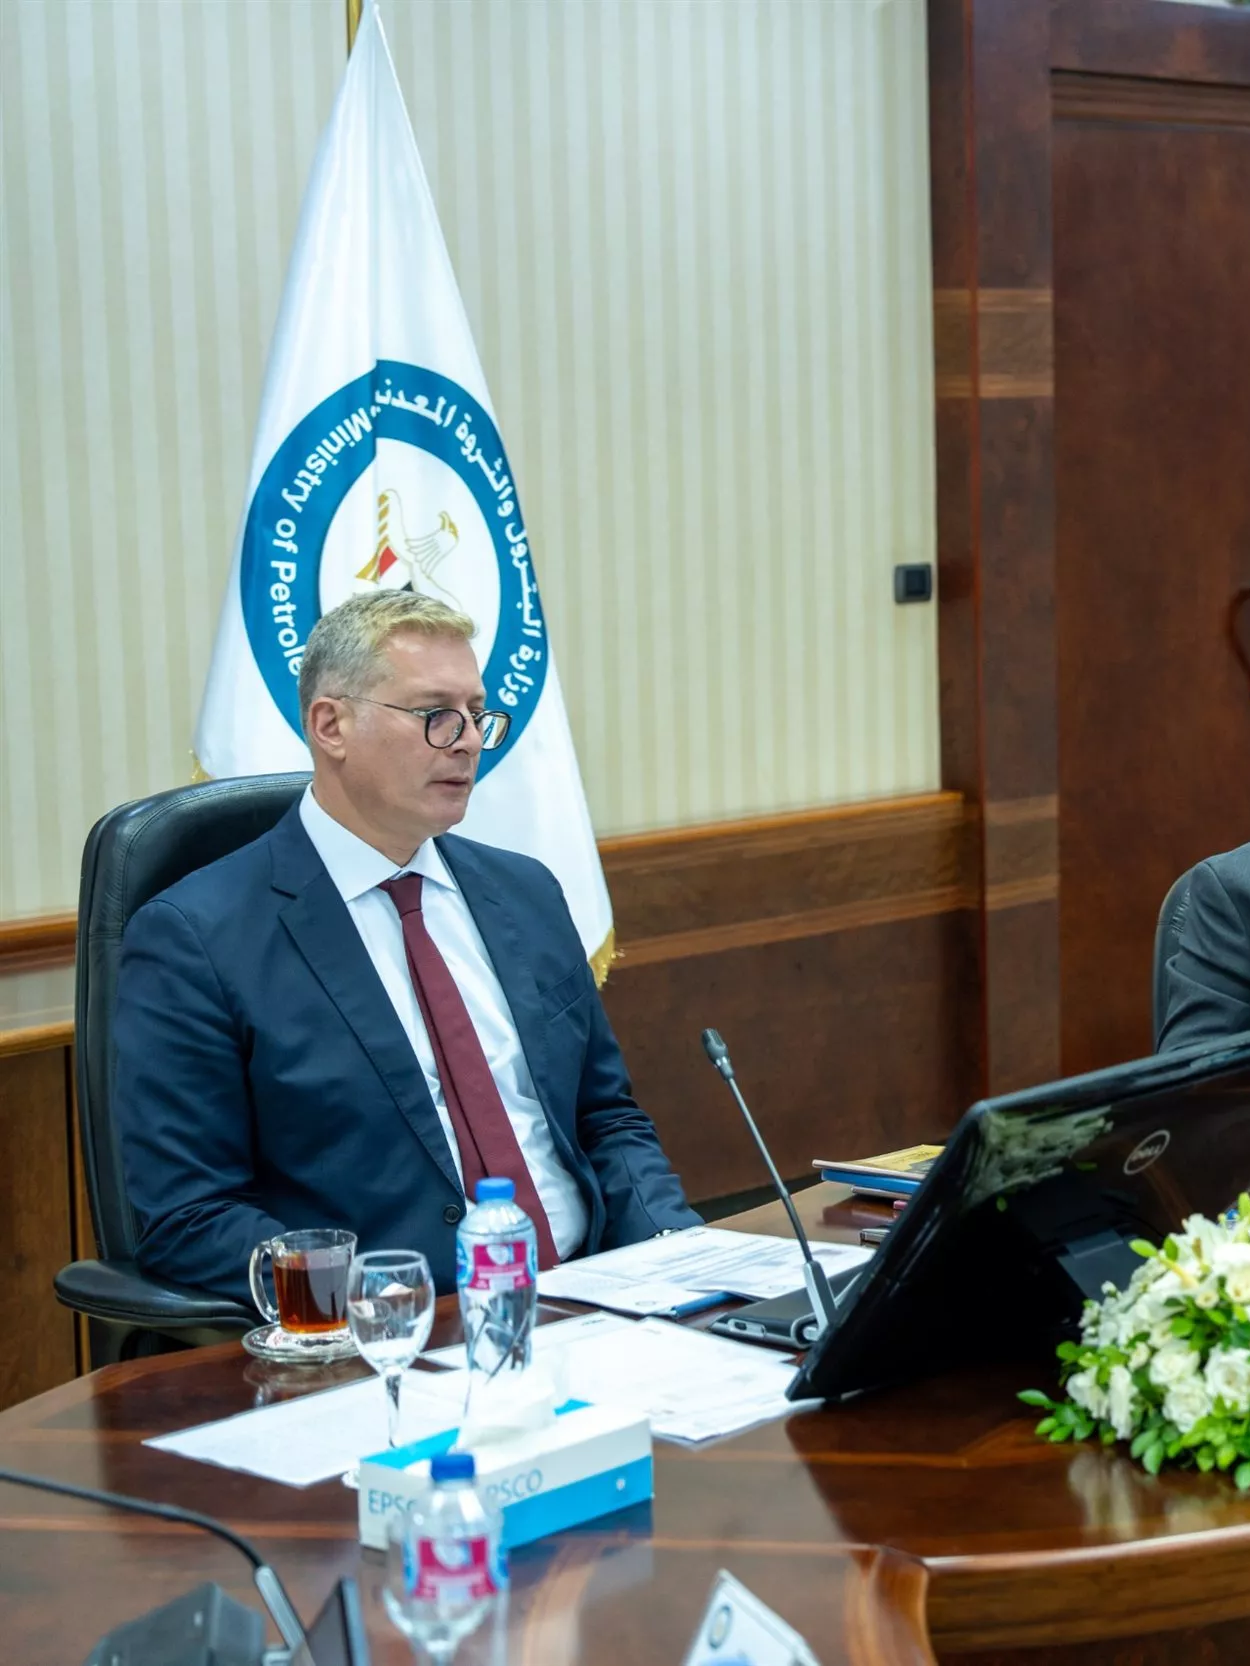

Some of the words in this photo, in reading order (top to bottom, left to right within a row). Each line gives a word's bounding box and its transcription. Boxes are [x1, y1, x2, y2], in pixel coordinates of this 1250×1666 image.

[281, 407, 374, 513] Ministry
[455, 412, 514, 517] والثروة
[275, 518, 298, 554] of
[505, 522, 542, 638] البترول
[269, 560, 305, 677] Petrole
[497, 644, 542, 707] وزارة
